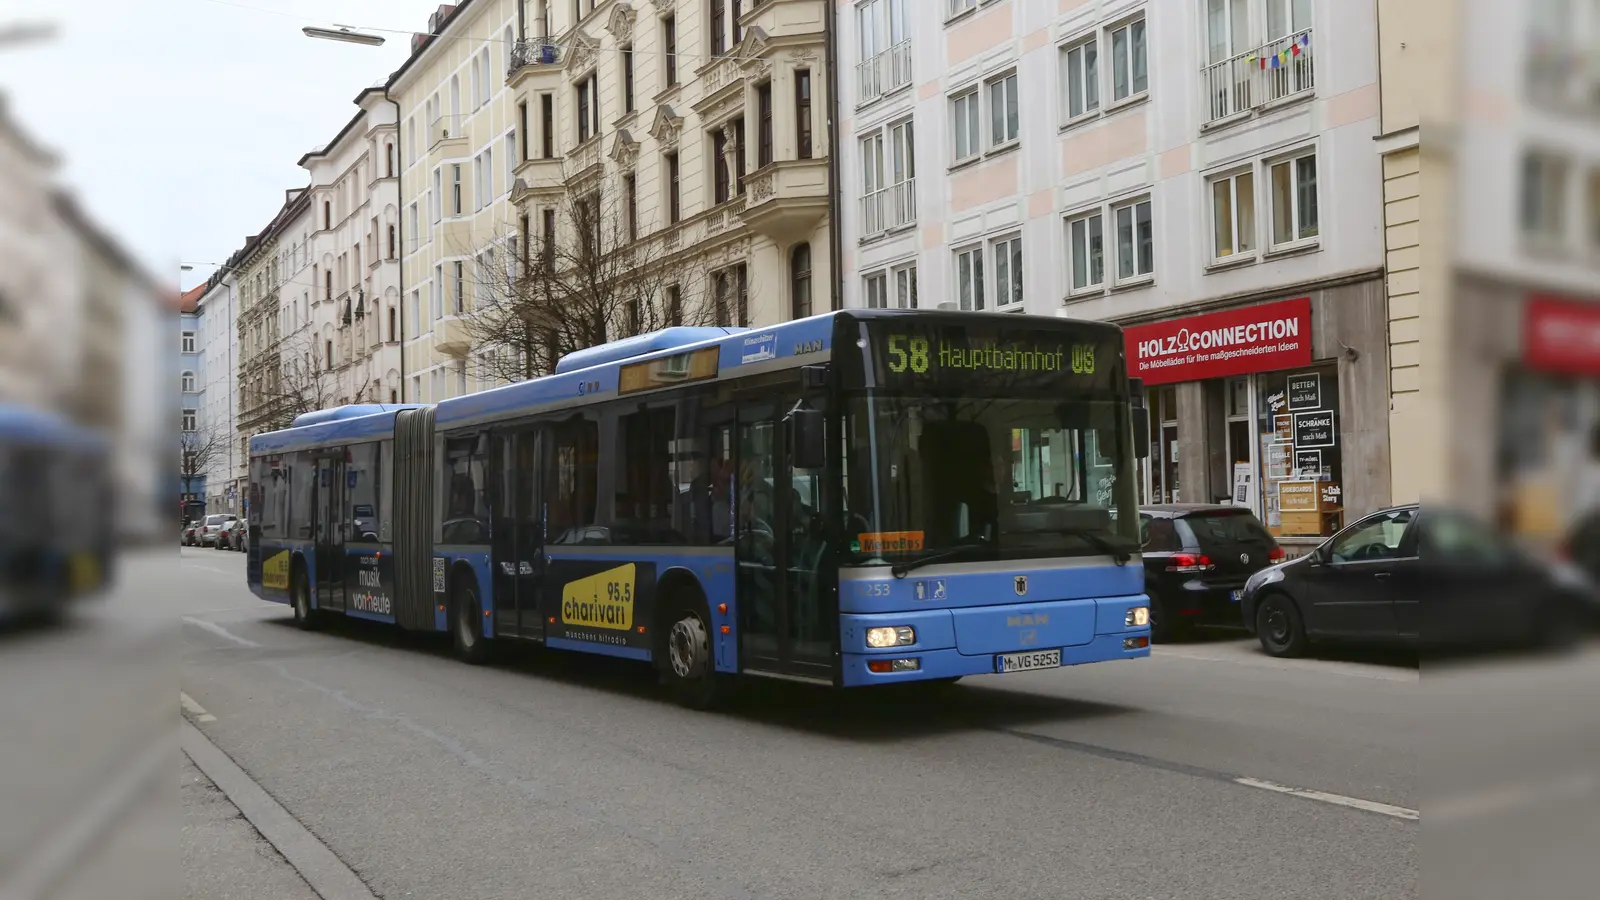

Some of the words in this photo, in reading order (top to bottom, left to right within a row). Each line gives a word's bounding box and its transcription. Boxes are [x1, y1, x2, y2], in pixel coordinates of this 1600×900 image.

[794, 339, 823, 355] MAN
[1138, 335, 1177, 359] HOLZ
[1189, 317, 1299, 351] CONNECTION
[888, 334, 929, 373] 58
[938, 338, 1063, 371] Hauptbahnhof
[1139, 361, 1150, 371] Die
[1150, 357, 1186, 369] Möbelläden
[1186, 354, 1196, 364] für
[1196, 353, 1209, 363] Ihre
[1210, 344, 1277, 361] maßgeschneiderten
[1278, 342, 1299, 352] Ideen
[1291, 380, 1316, 390] BETTEN
[1291, 394, 1304, 403] nach
[1298, 417, 1331, 428] SCHRÄNKE
[864, 537, 920, 550] MetroBus
[358, 567, 381, 588] musik
[607, 581, 631, 603] 95.5
[564, 594, 625, 625] charivari
[1017, 655, 1031, 668] VG
[1033, 652, 1059, 667] 5253
